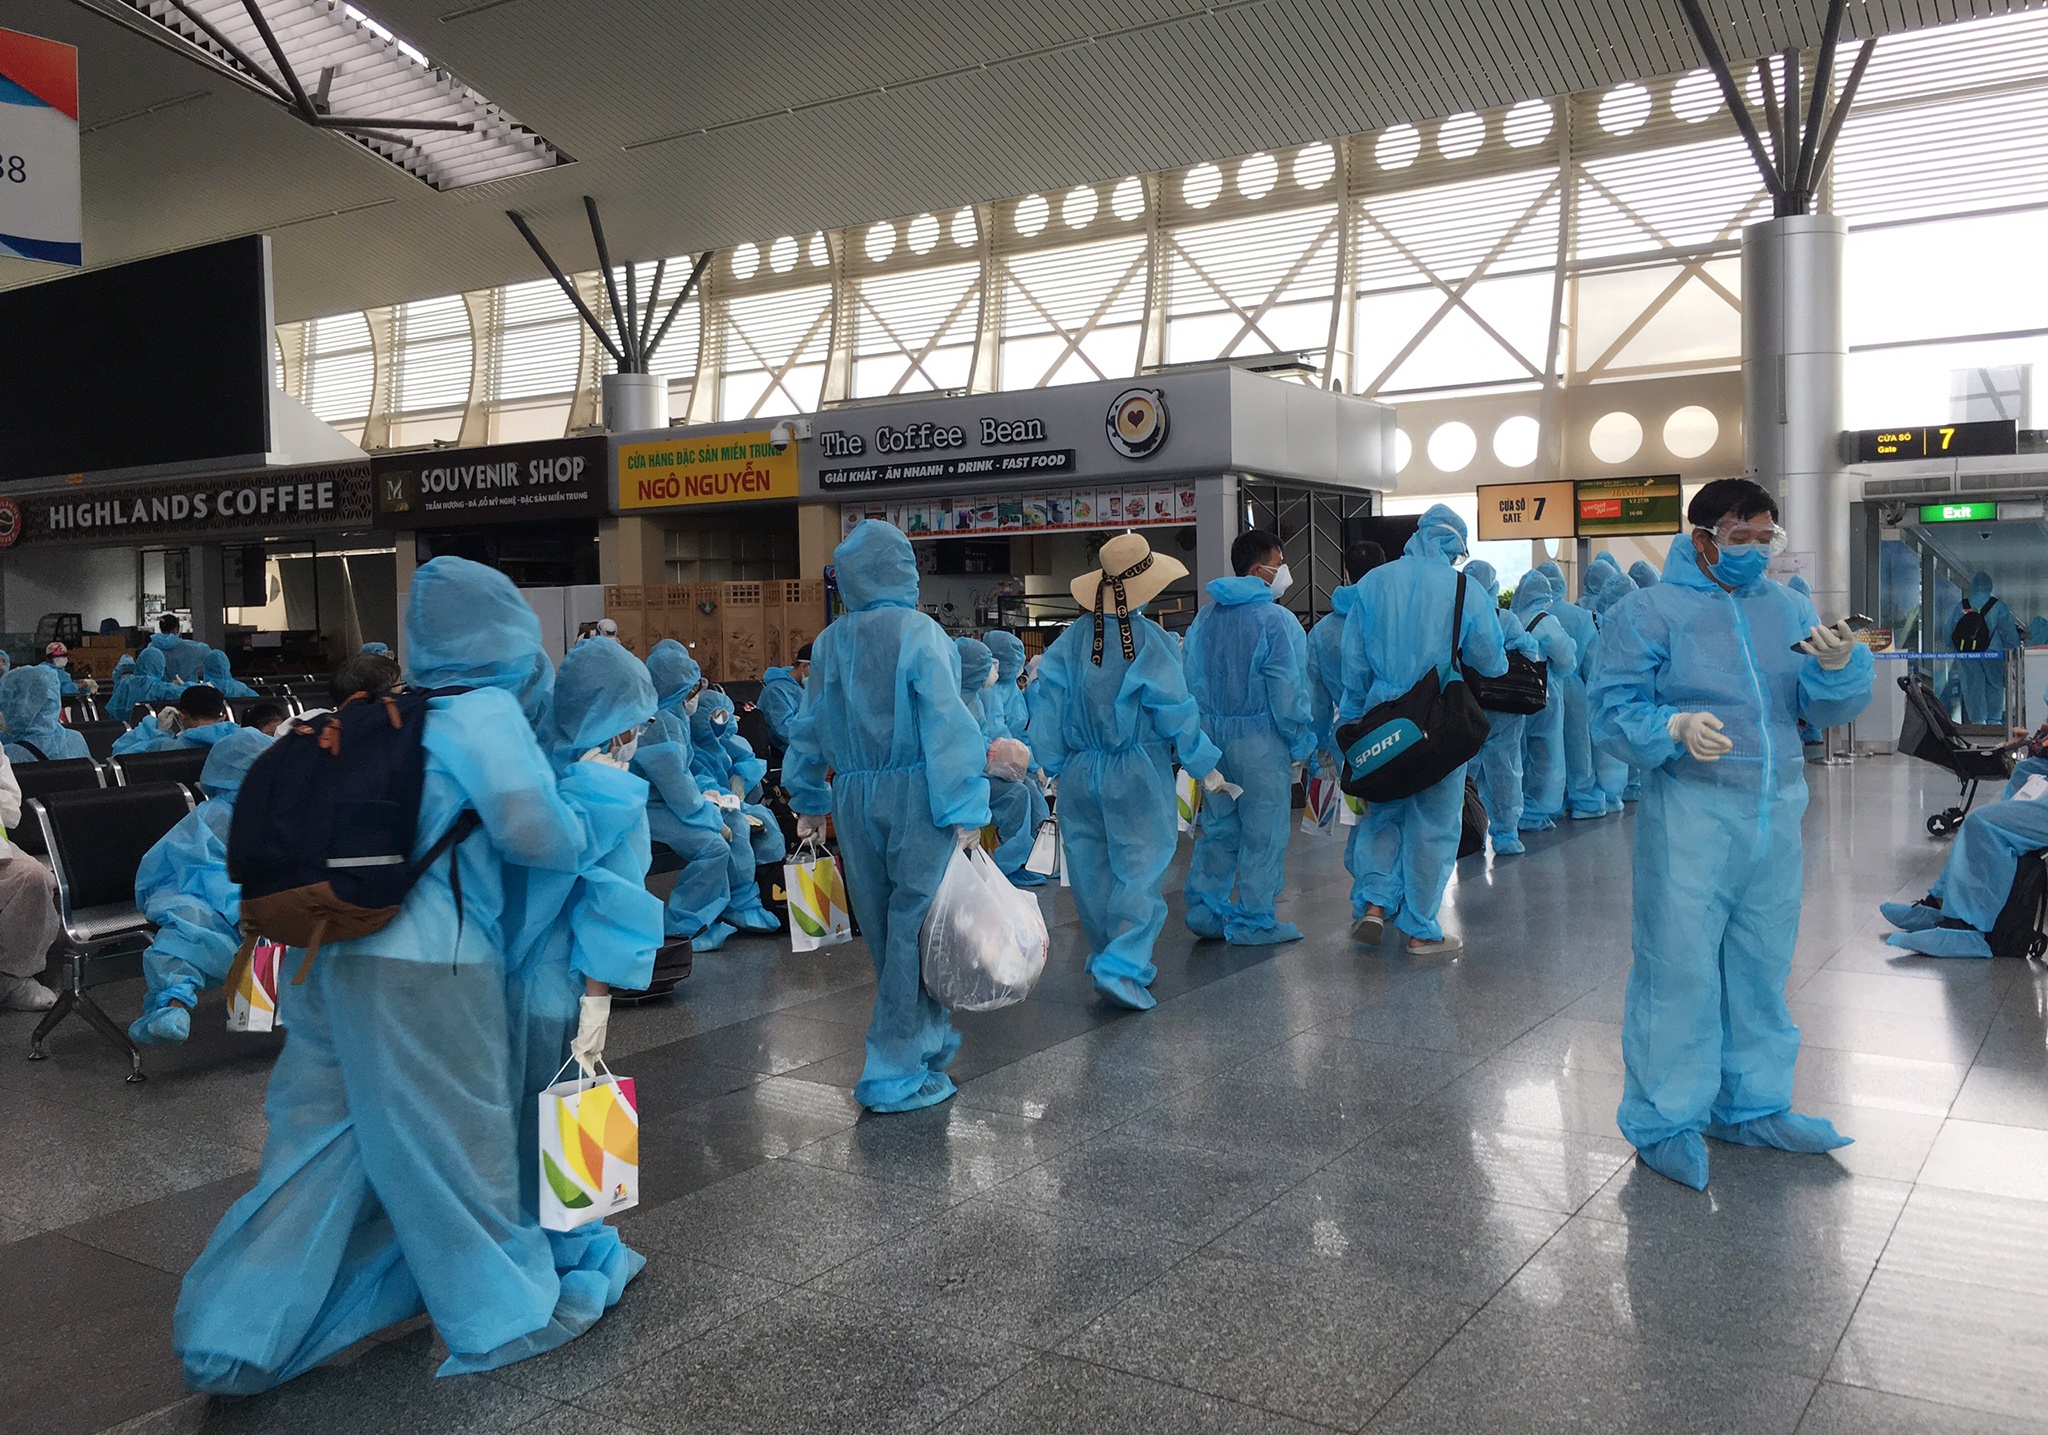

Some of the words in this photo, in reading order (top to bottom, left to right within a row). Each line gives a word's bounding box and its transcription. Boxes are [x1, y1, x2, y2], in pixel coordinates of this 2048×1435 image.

[0, 154, 26, 183] 8
[820, 431, 864, 457] The
[875, 423, 964, 453] Coffee
[980, 418, 1045, 444] Bean
[1877, 445, 1897, 454] Gate
[1939, 428, 1954, 450] 7
[421, 462, 520, 494] SOUVENIR
[529, 456, 586, 485] SHOP
[885, 466, 902, 480] ĂN
[903, 464, 944, 478] NHANH
[957, 459, 994, 473] DRINK
[1002, 456, 1031, 470] FAST
[1031, 454, 1066, 468] FOOD
[638, 472, 681, 500] NGÔ
[685, 461, 771, 497] NGUYỄN
[50, 493, 208, 530] HIGHLANDS
[217, 481, 334, 517] COFFEE
[565, 491, 588, 501] TRUNG
[1533, 497, 1546, 521] 7
[1503, 513, 1522, 523] GATE
[1943, 506, 1971, 519] Exit
[1125, 554, 1154, 578] GUCCI
[1121, 623, 1134, 661] GUCCI
[1355, 729, 1402, 768] SPORT
